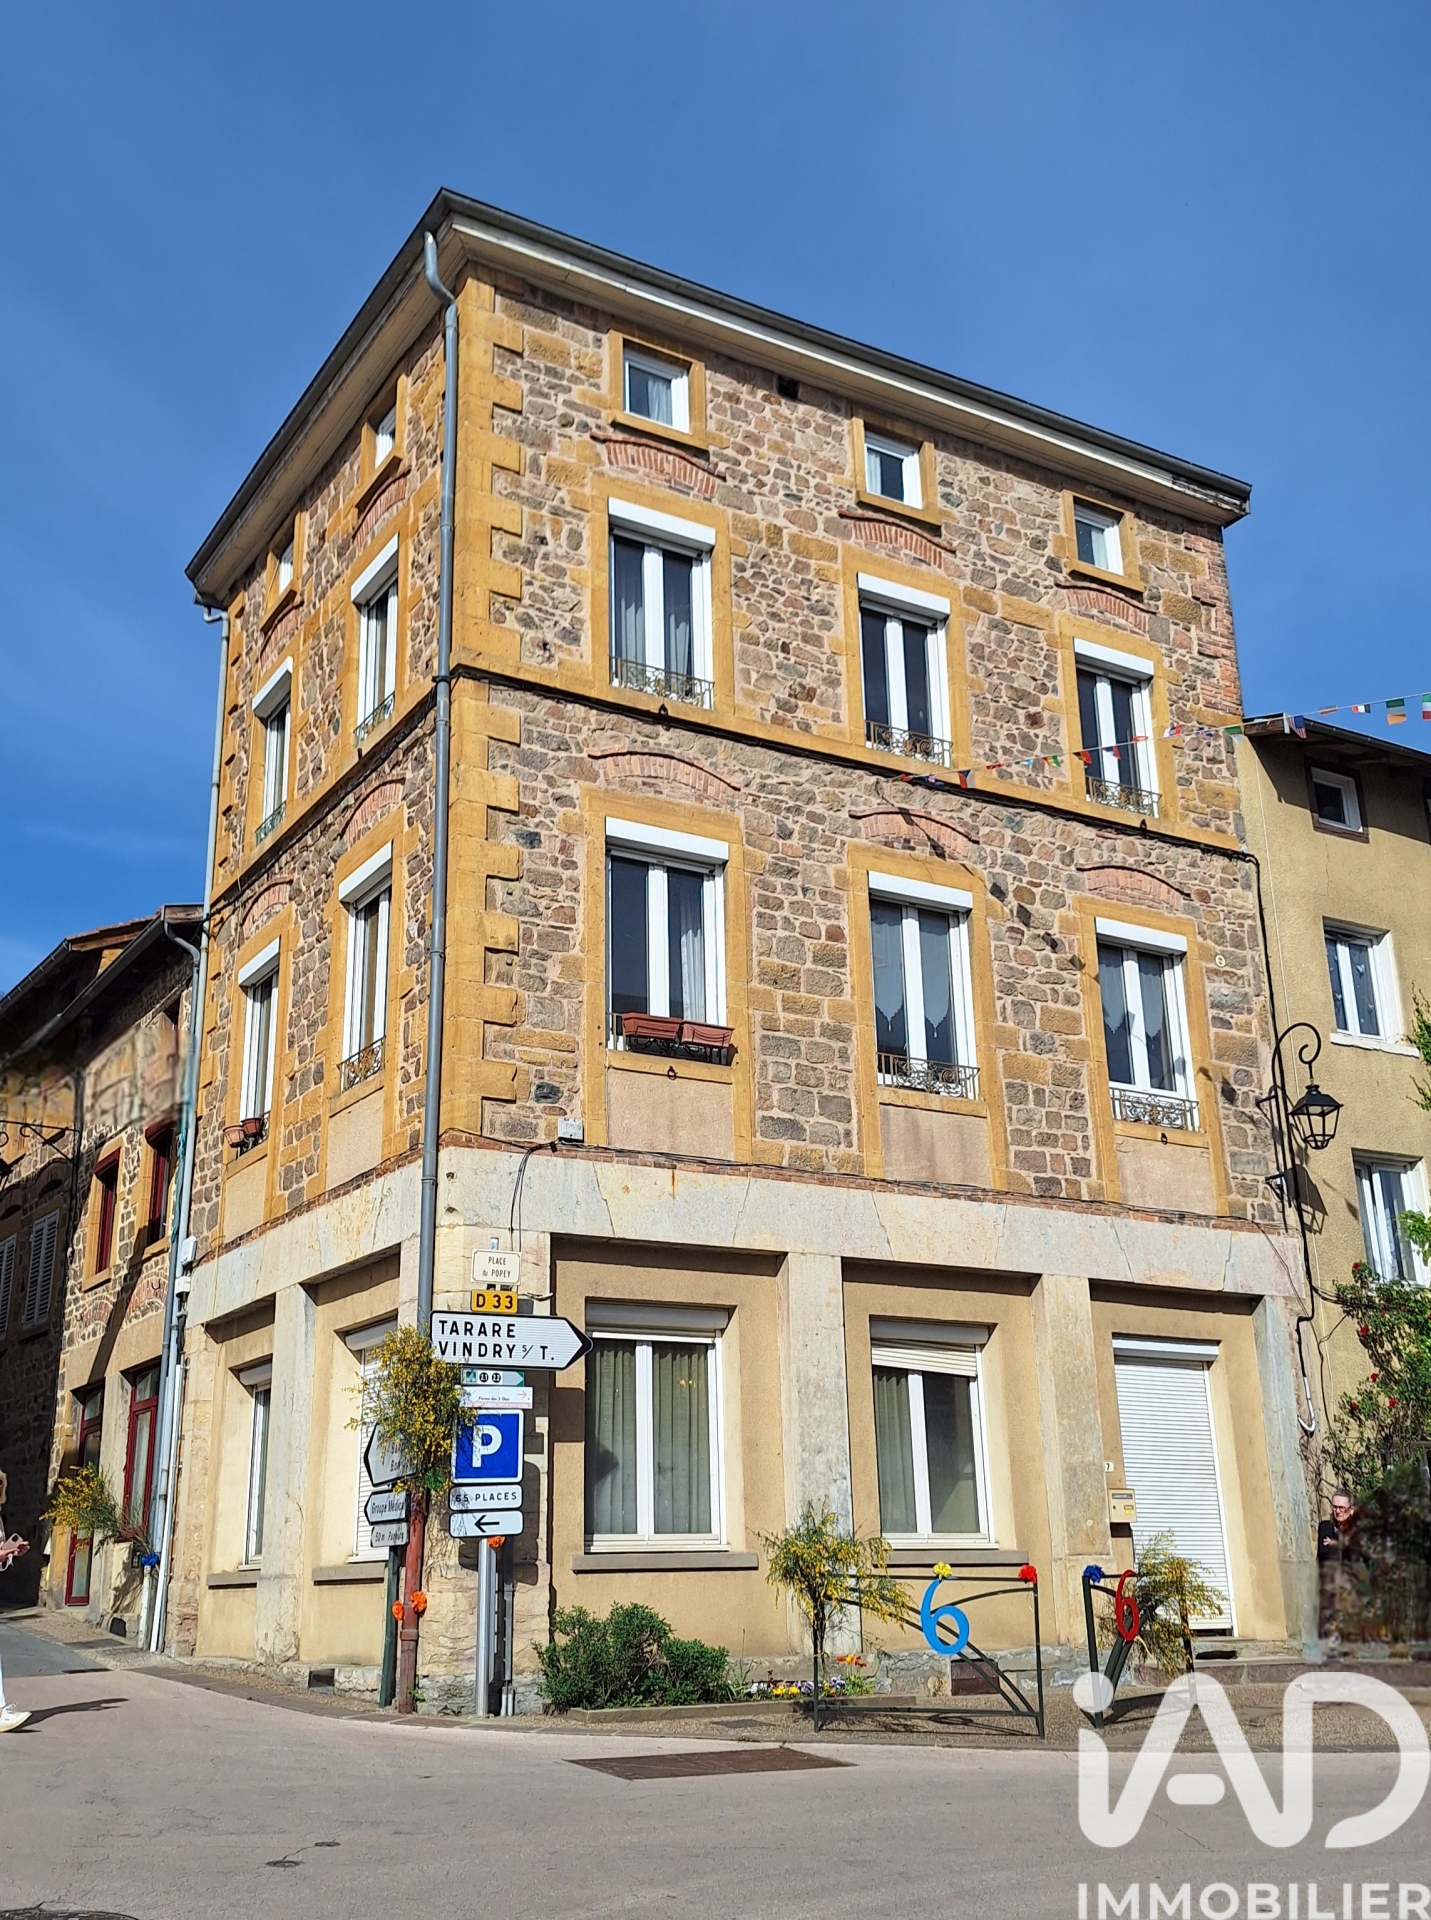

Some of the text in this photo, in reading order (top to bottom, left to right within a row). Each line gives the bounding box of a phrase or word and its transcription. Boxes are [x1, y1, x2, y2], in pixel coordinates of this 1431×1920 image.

[488, 1256, 507, 1266] PLACE
[482, 1268, 511, 1278] du POPEY
[476, 1293, 514, 1310] D 33
[438, 1320, 516, 1338] TARARE
[438, 1340, 516, 1359] VINDRY
[540, 1345, 555, 1361] T.
[472, 1424, 503, 1468] P
[475, 1491, 517, 1502] PLACES
[371, 1502, 387, 1516] Groupe
